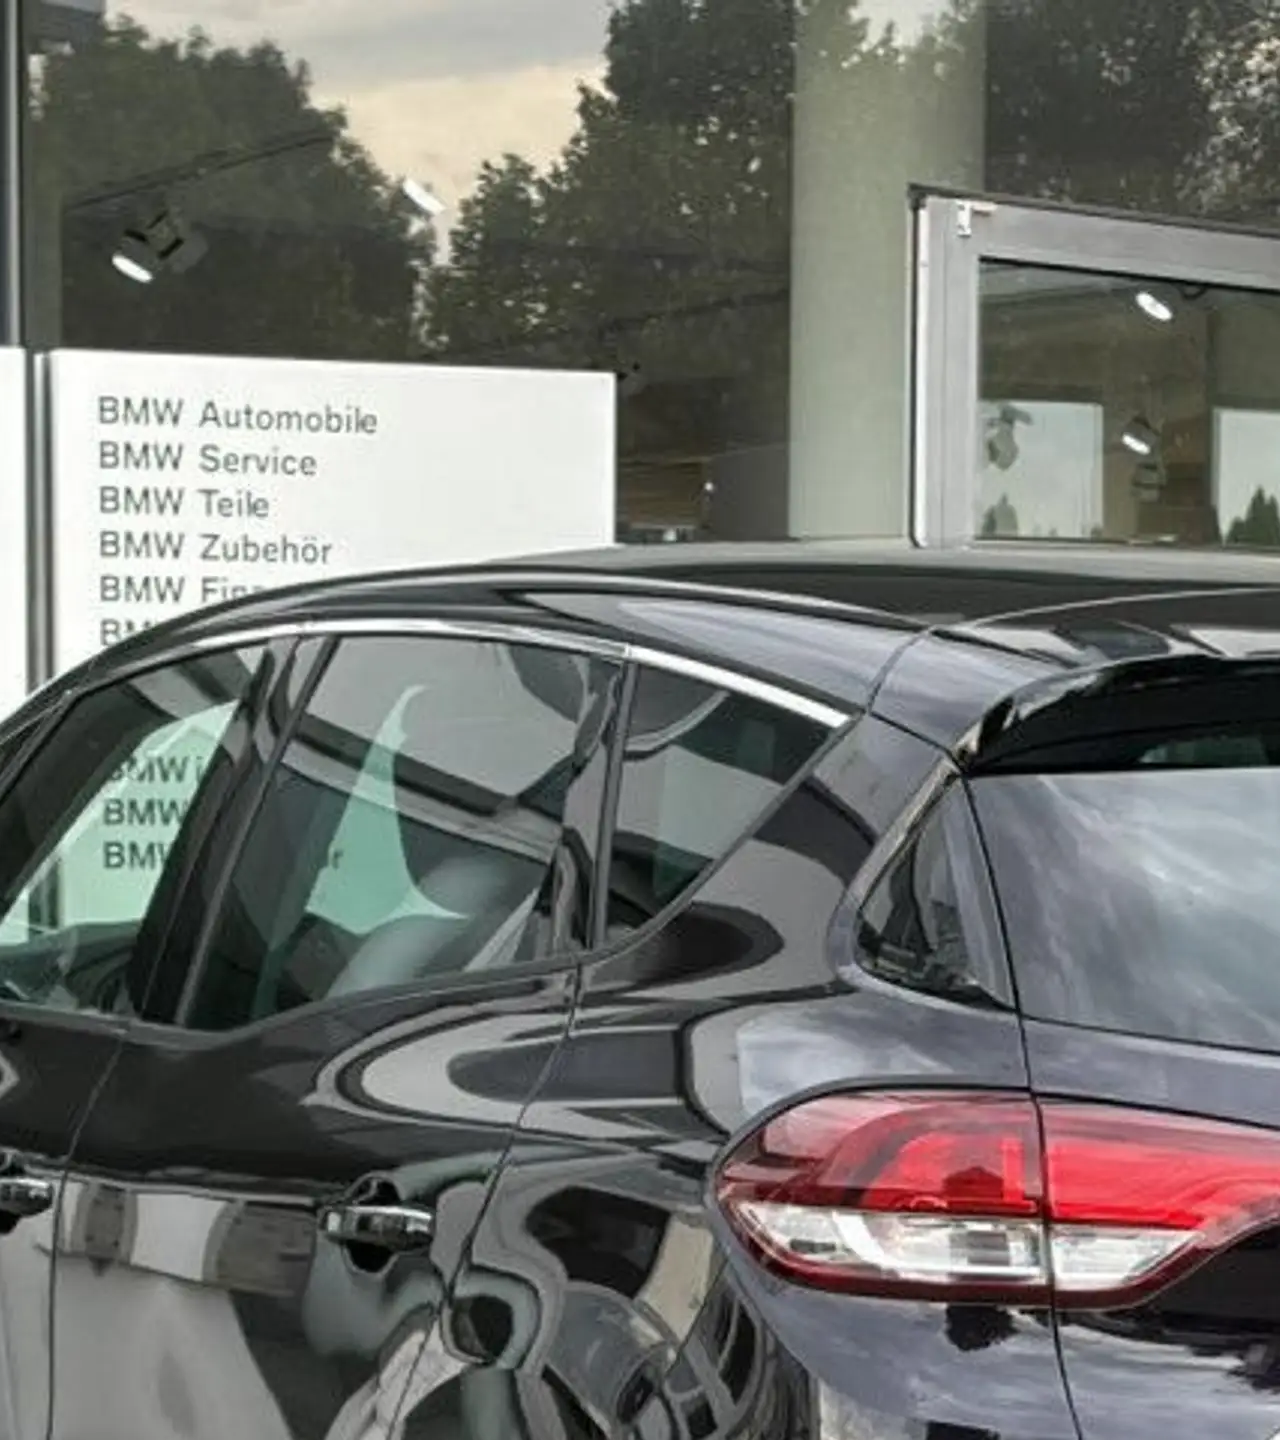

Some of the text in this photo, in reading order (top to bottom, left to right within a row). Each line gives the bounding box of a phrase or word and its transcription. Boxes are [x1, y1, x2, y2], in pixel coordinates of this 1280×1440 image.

[98, 396, 377, 434] BMW Automobile
[100, 441, 317, 476] BMW Service
[100, 486, 270, 519] BMW Teile
[100, 530, 332, 564] BMW Zubehör
[100, 574, 185, 604] BMW
[111, 755, 189, 784] MW
